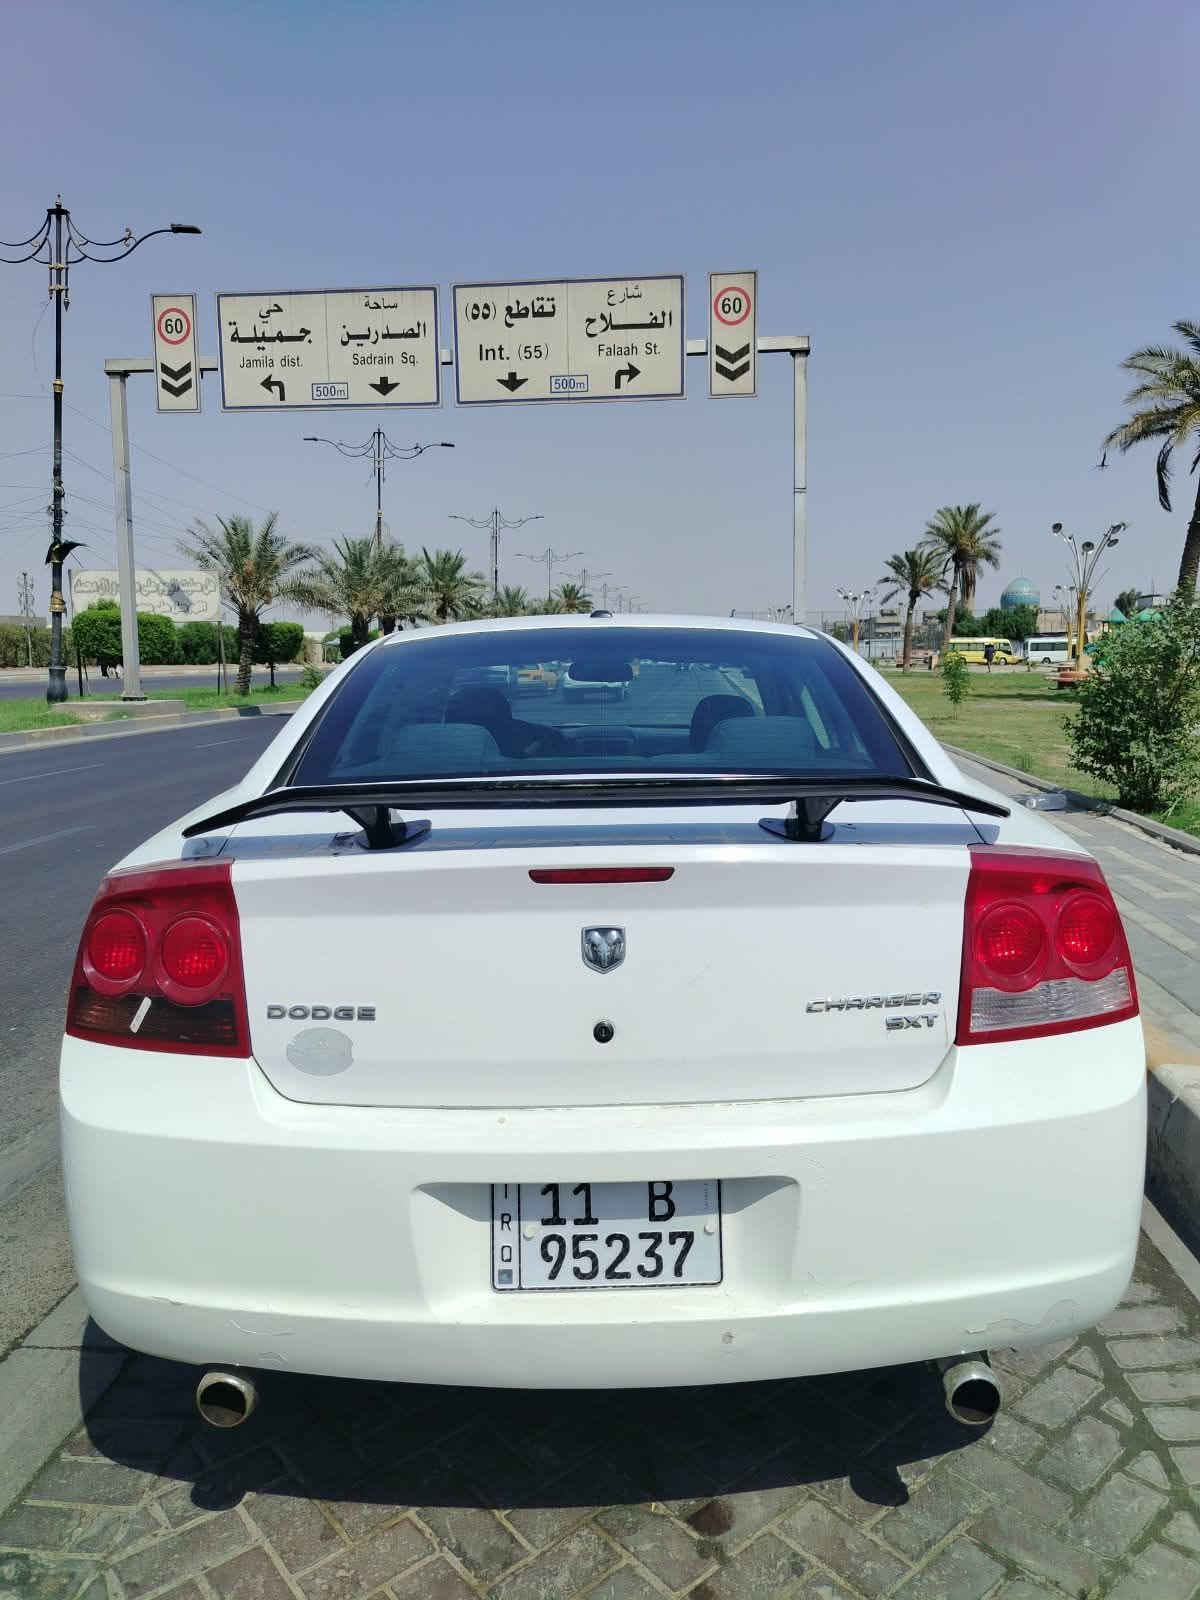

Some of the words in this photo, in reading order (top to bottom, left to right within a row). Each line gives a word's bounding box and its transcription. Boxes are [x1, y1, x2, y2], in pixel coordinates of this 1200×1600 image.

[364, 296, 398, 310] ساحة
[607, 284, 642, 306] شارع
[259, 304, 284, 324] حي
[504, 297, 556, 328] تقاطع
[721, 297, 742, 314] 60
[164, 318, 184, 334] 60
[585, 311, 673, 338] الفلاح
[228, 321, 313, 351] جميلة
[340, 321, 427, 347] الصدرين
[352, 352, 394, 366] Sadrain
[401, 351, 418, 366] Sq.
[478, 345, 510, 361] Int.
[518, 344, 549, 361] (55)
[598, 343, 638, 357] Falaah
[645, 343, 661, 356] St.
[239, 356, 275, 369] Jamila
[280, 355, 304, 368] dist.
[315, 385, 346, 398] 500m
[554, 378, 586, 391] 500m
[805, 991, 942, 1014] CHARGER
[267, 1004, 376, 1021] DODGE
[886, 1014, 939, 1031] SXT
[540, 1182, 599, 1226] 11
[647, 1181, 676, 1223] B
[540, 1230, 695, 1281] 95237
